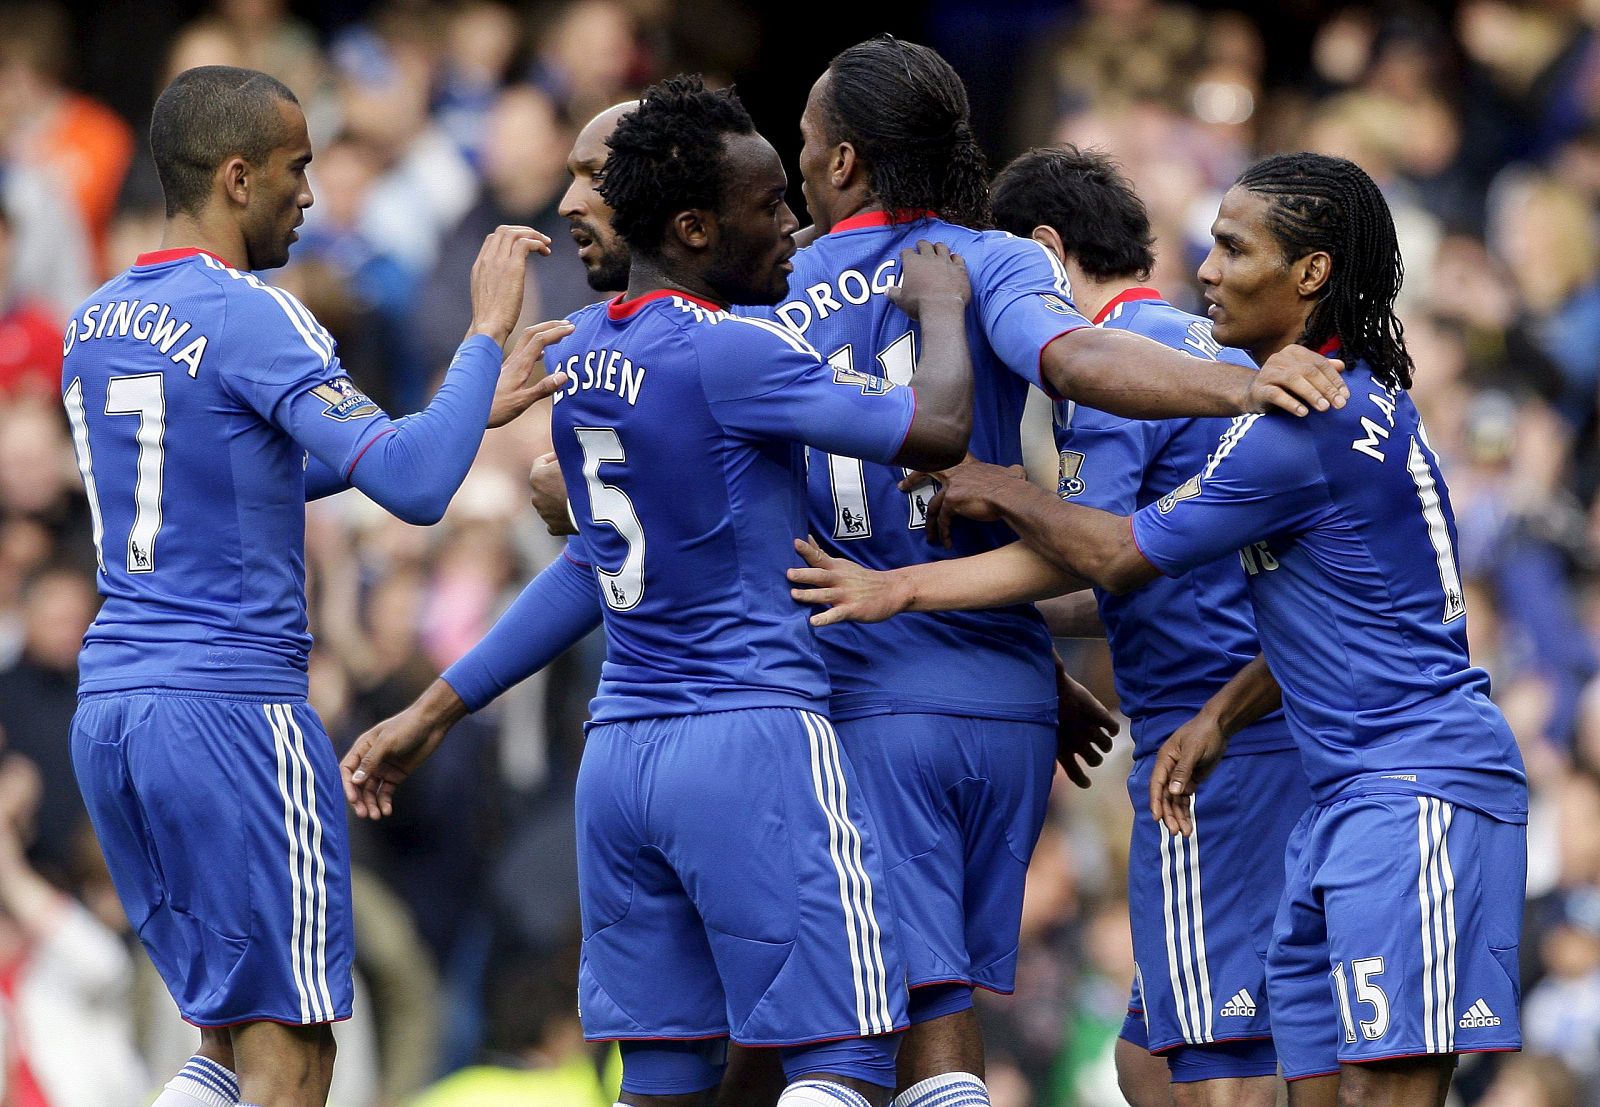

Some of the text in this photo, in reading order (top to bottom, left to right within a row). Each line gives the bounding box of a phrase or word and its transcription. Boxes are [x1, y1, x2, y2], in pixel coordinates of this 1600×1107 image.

[63, 371, 165, 575] 17
[573, 426, 646, 612] 5
[1332, 956, 1391, 1043] 15
[1458, 1016, 1501, 1029] adidas
